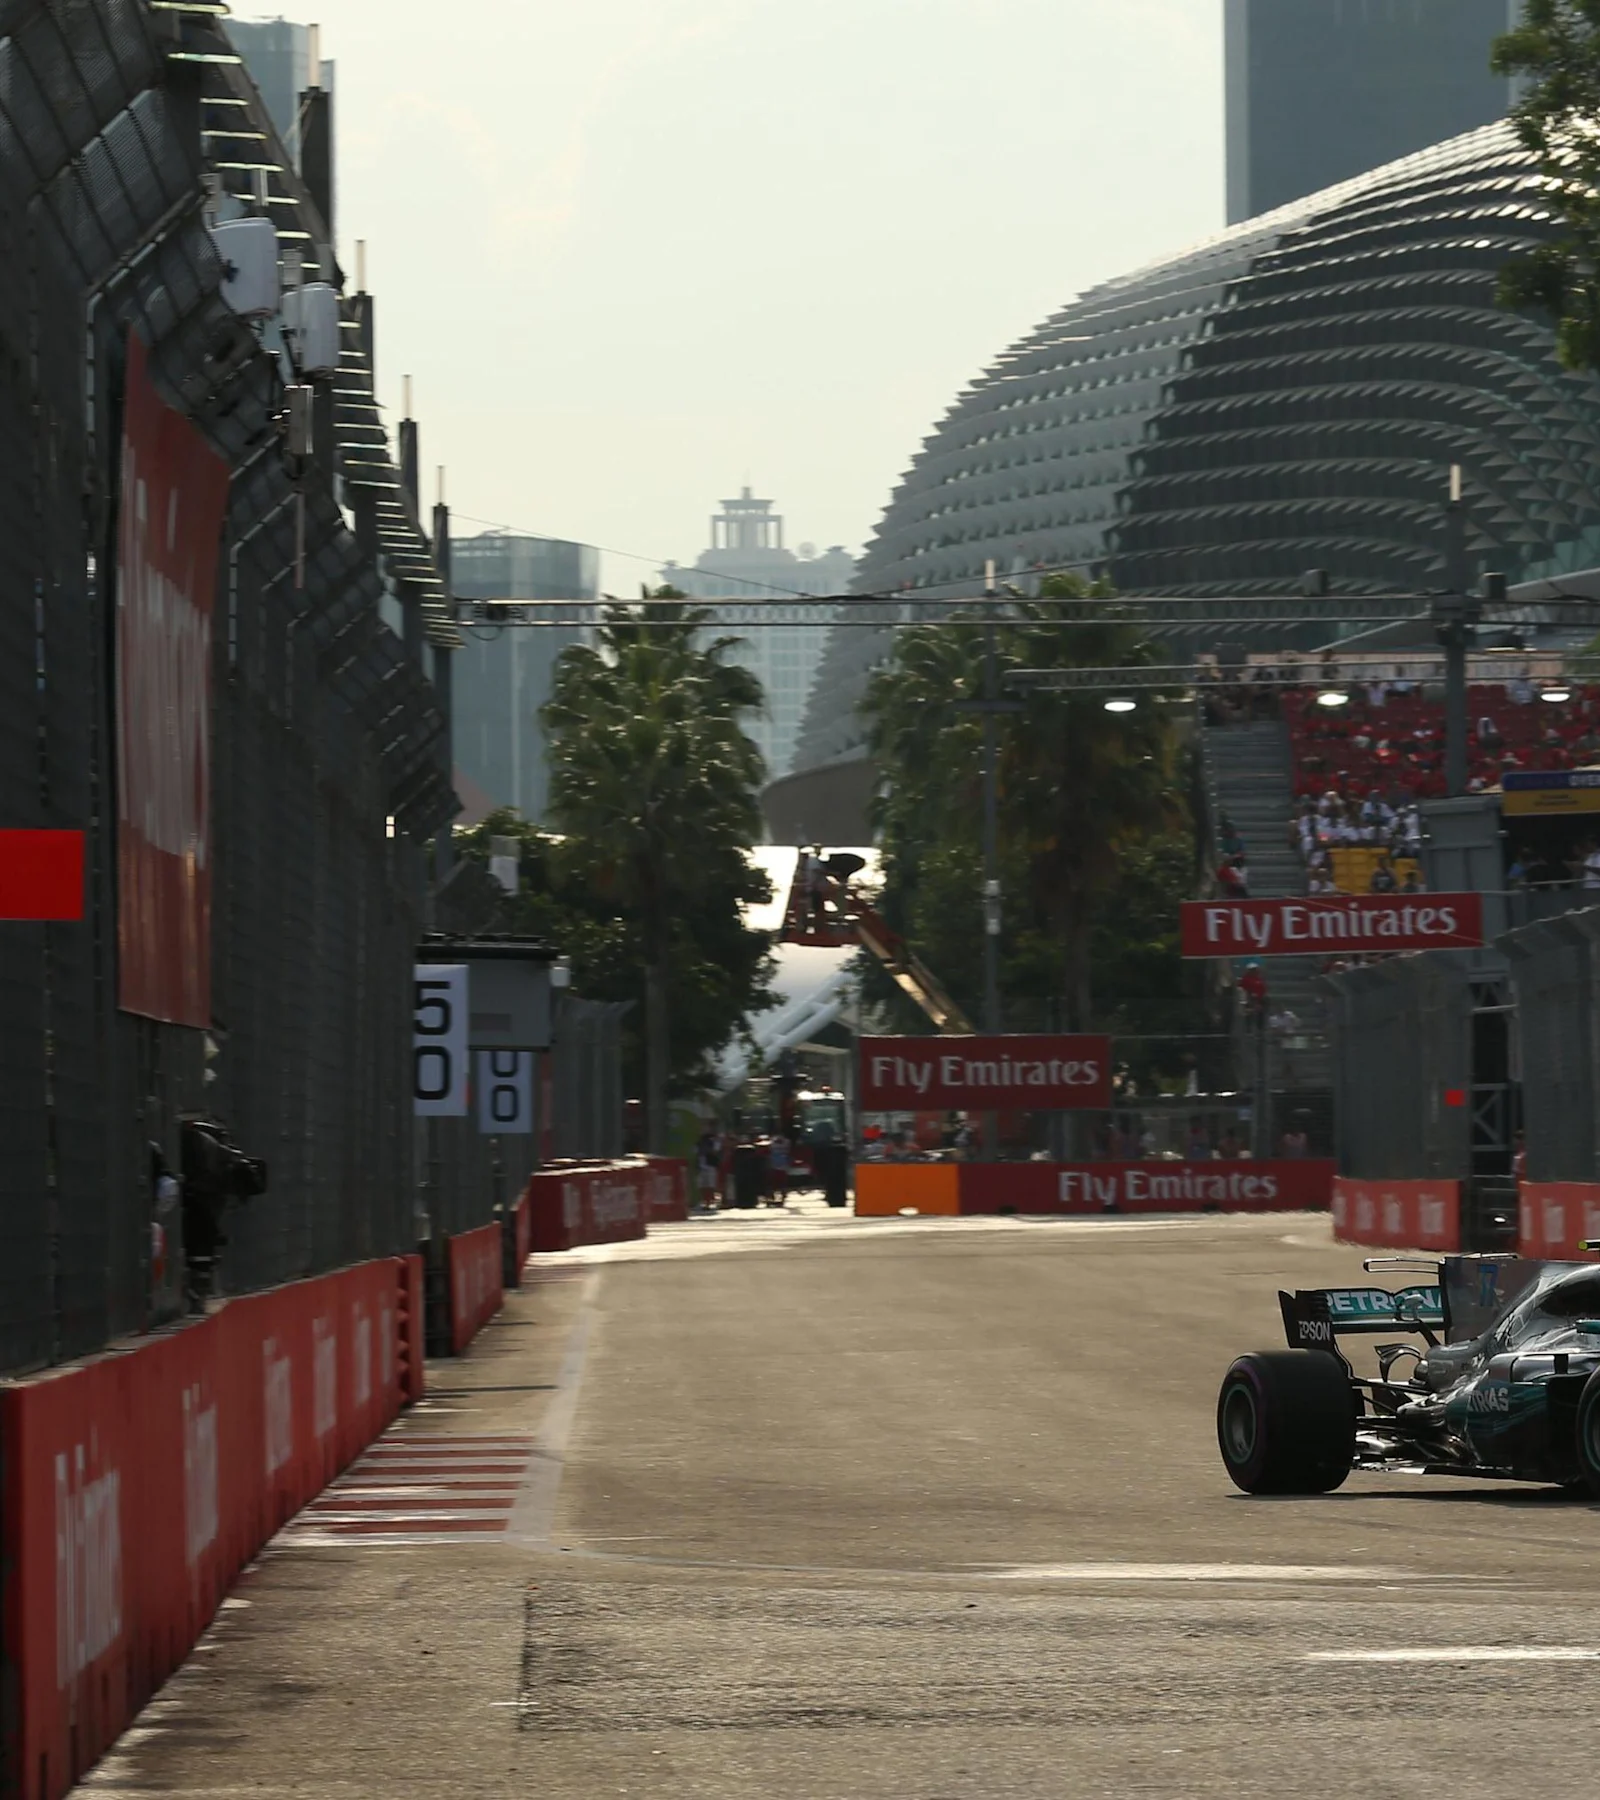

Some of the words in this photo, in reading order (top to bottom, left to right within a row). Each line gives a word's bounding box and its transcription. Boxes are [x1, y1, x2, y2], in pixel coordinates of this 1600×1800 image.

[1205, 907, 1272, 948] Fly
[1280, 902, 1457, 940] Emirates
[871, 1055, 931, 1093] Fly
[940, 1053, 1099, 1087] Emirates
[1058, 1170, 1119, 1203] Fly
[1125, 1167, 1279, 1201] Emirates
[1298, 1320, 1331, 1341] EPSON
